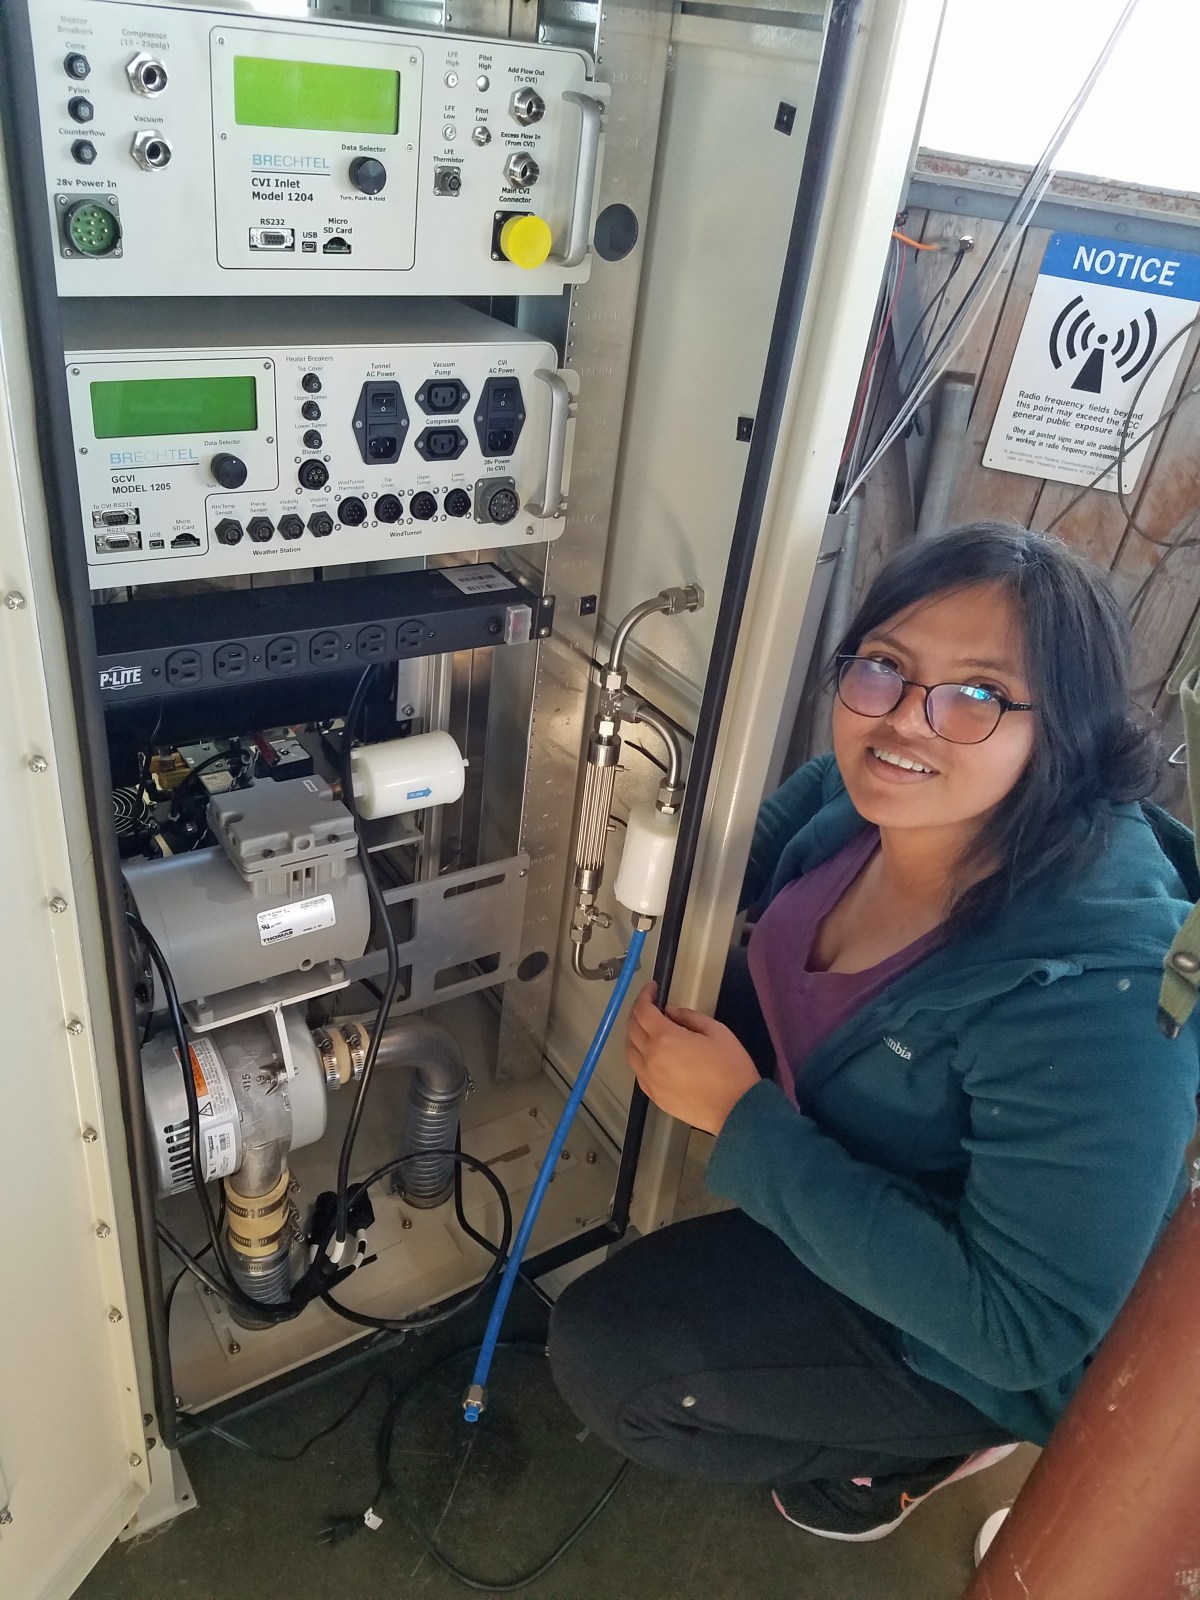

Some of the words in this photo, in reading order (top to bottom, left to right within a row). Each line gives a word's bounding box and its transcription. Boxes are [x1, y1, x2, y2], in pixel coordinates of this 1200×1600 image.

[122, 29, 167, 39] Compressor
[134, 115, 164, 123] Vacuum
[59, 128, 105, 137] Counterflow
[252, 154, 330, 168] BRECHTEL
[56, 179, 72, 187] 28v
[251, 178, 270, 188] CVI
[275, 178, 300, 188] Inlet
[252, 191, 283, 201] Model
[288, 193, 314, 202] 1204
[1073, 246, 1180, 286] NOTICE
[1019, 390, 1041, 401] Radio
[1045, 395, 1084, 410] frequency
[1089, 403, 1110, 414] fields
[1114, 408, 1143, 420] beynd
[1016, 400, 1030, 410] this
[1033, 403, 1054, 414] point
[1057, 409, 1073, 417] may
[1076, 412, 1104, 423] exceed
[1107, 417, 1119, 426] the
[1012, 410, 1043, 421] general
[1046, 415, 1070, 427] public
[1075, 422, 1113, 435] exposure
[1013, 426, 1026, 435] Obey
[1037, 431, 1056, 440] posted
[1074, 437, 1084, 445] and
[1086, 440, 1096, 448] site
[1098, 443, 1126, 453] guidelin
[1016, 436, 1036, 447] working
[1046, 441, 1059, 449] radio
[1062, 443, 1088, 456] frequency
[1090, 448, 1126, 462] environmes.
[110, 449, 198, 464] BRECHTEL
[112, 475, 135, 483] GCVI
[112, 485, 147, 494] MODEL
[150, 483, 171, 491] 1205
[263, 931, 293, 942] THOMAS
